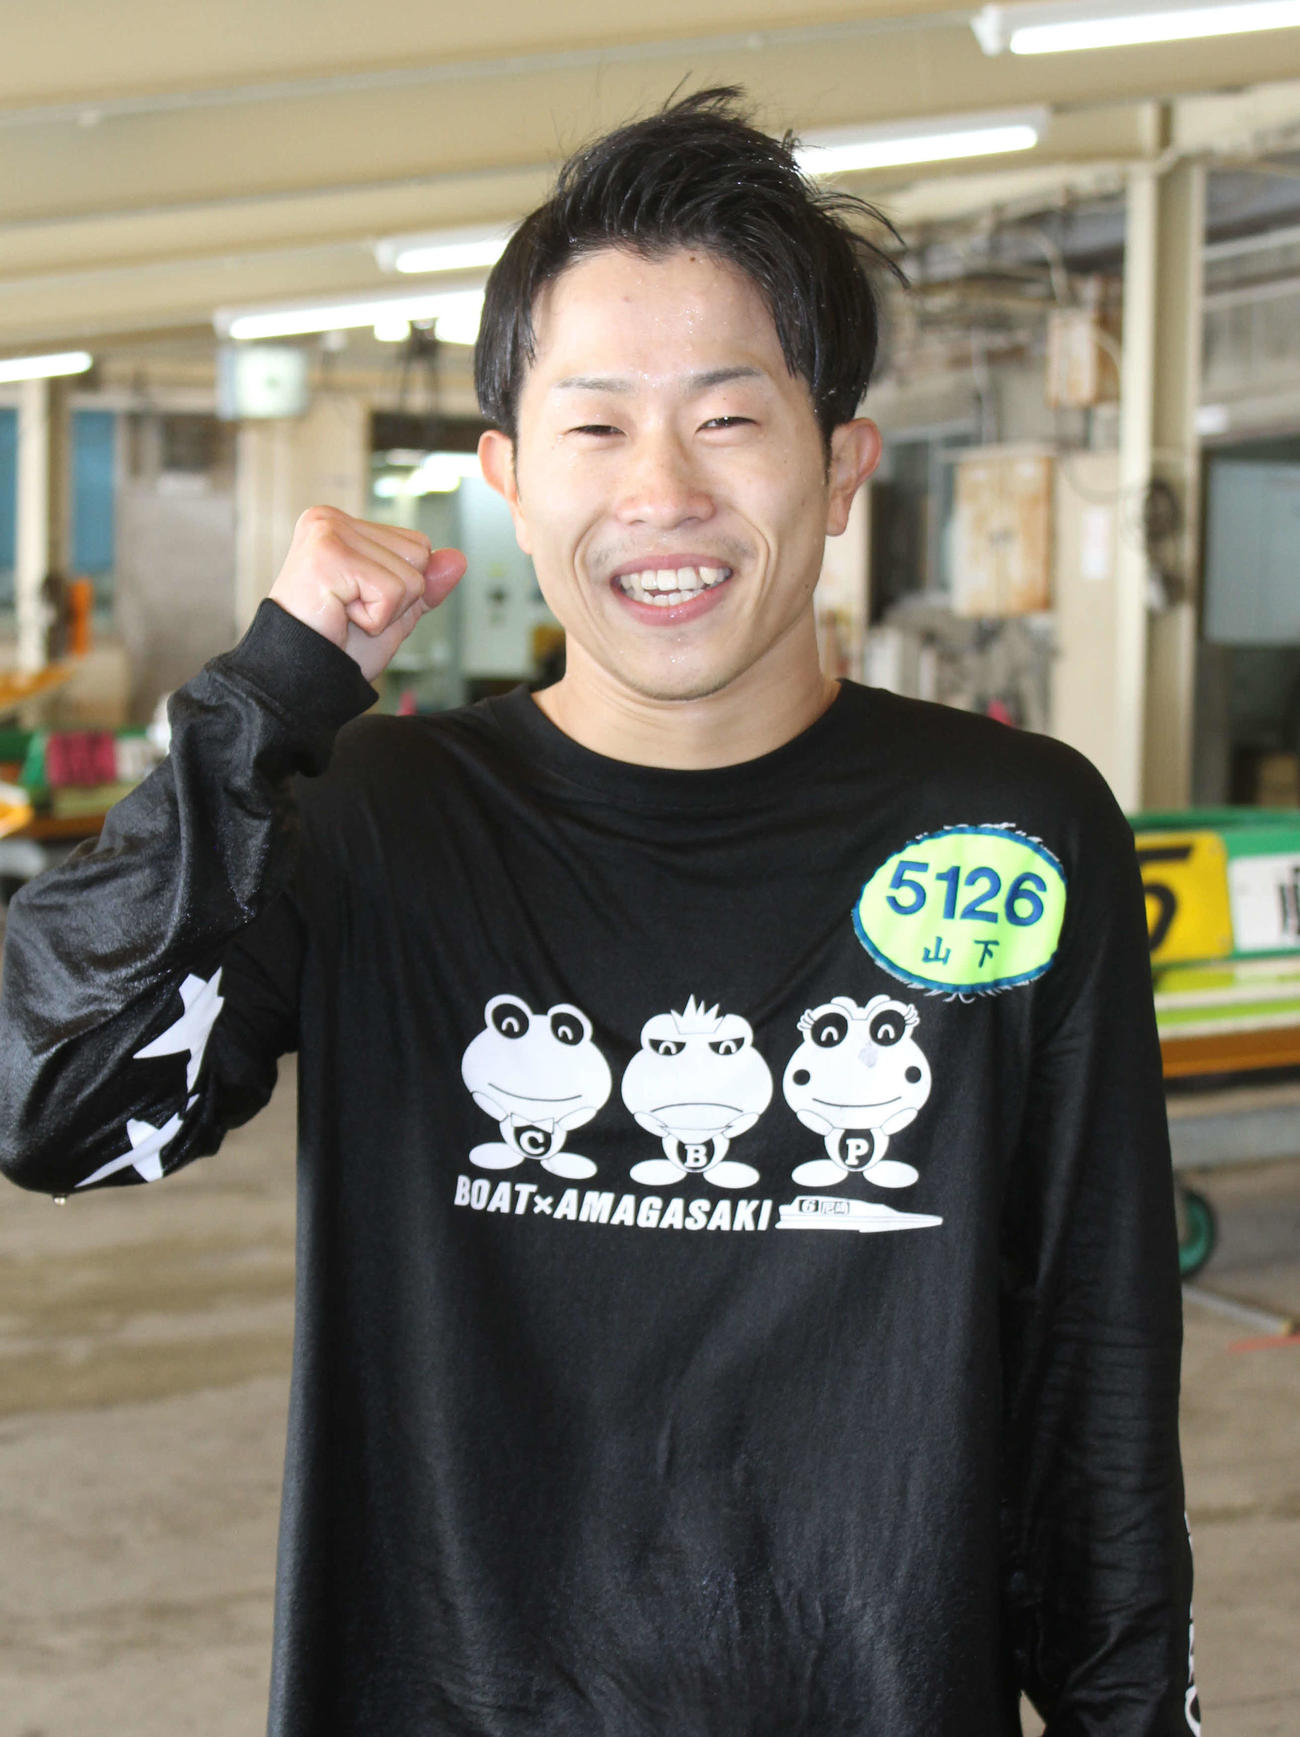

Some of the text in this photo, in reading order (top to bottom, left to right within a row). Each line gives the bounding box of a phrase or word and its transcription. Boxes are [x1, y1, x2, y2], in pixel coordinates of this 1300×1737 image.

[886, 860, 1047, 927] 5126
[520, 1130, 544, 1154] C
[845, 1138, 869, 1165] P
[684, 1144, 708, 1167] B
